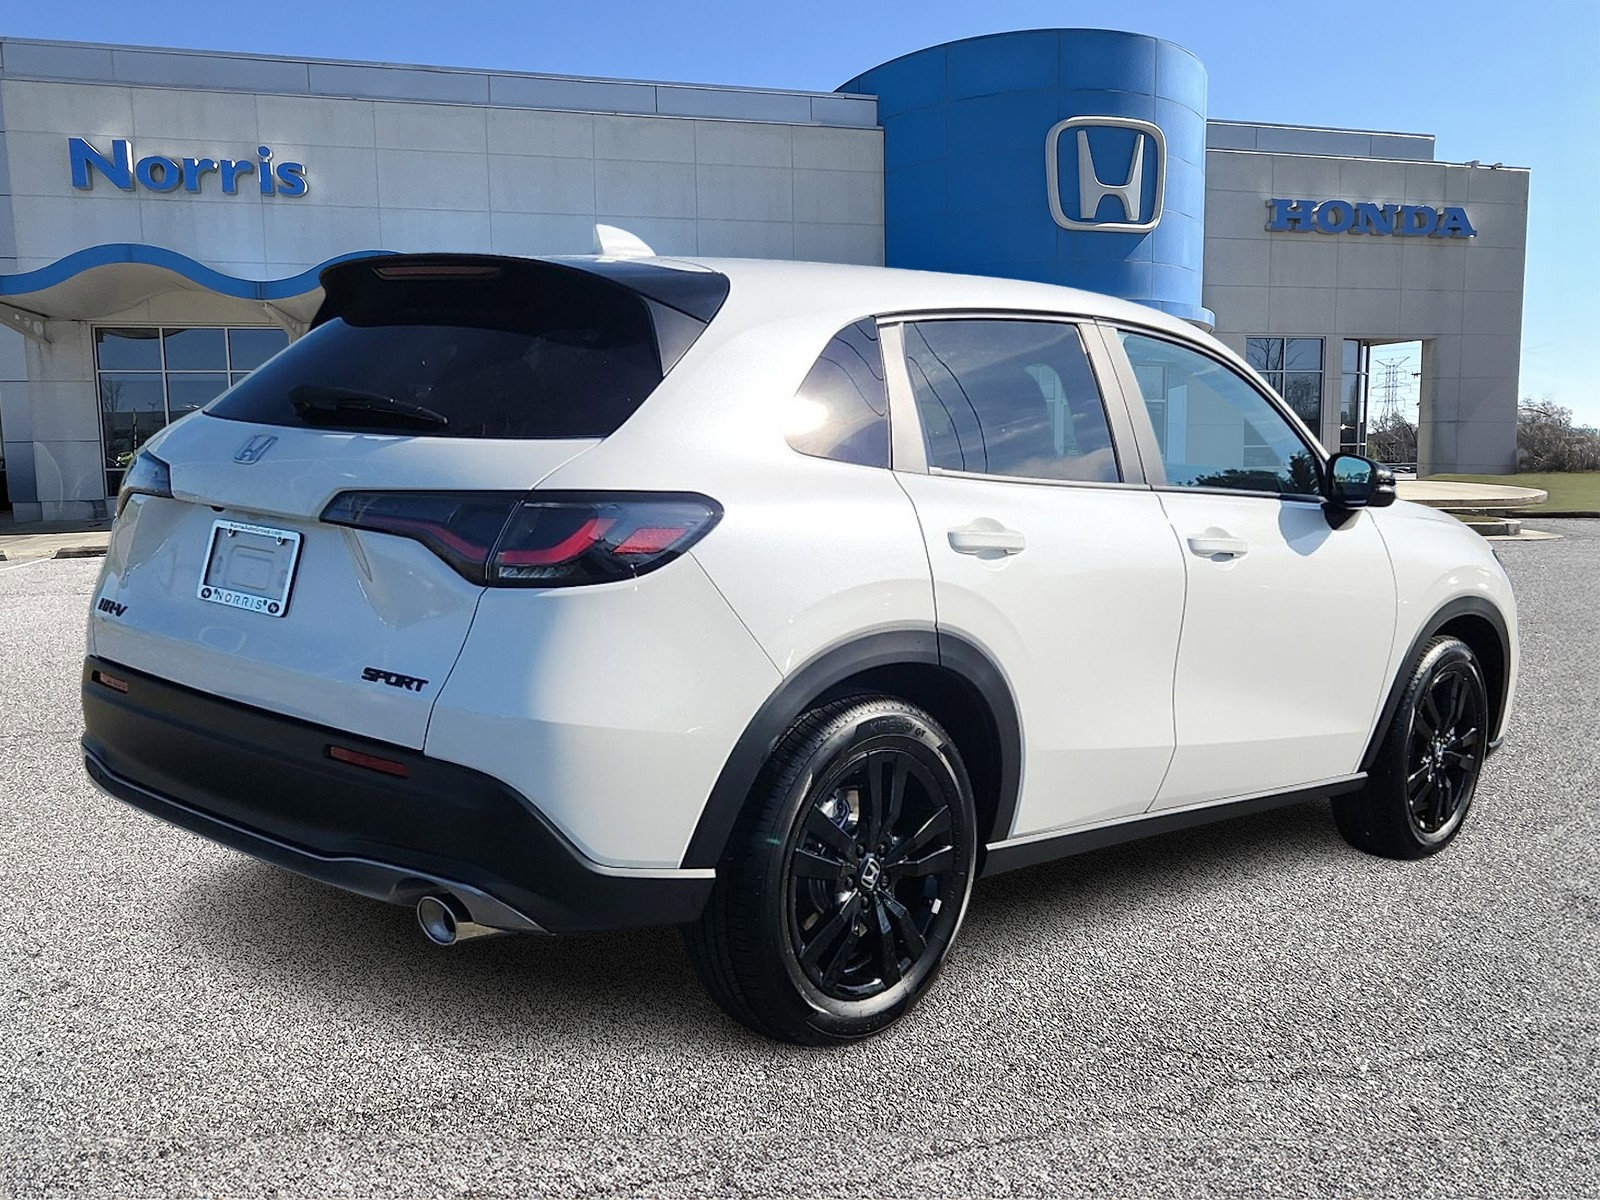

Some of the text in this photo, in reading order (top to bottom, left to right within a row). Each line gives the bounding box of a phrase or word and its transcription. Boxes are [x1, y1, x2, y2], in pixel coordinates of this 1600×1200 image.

[68, 137, 309, 197] Norris
[1265, 198, 1478, 239] HONDA
[97, 597, 129, 617] HR-V
[215, 592, 263, 610] NORRIS
[361, 667, 429, 692] SPORT
